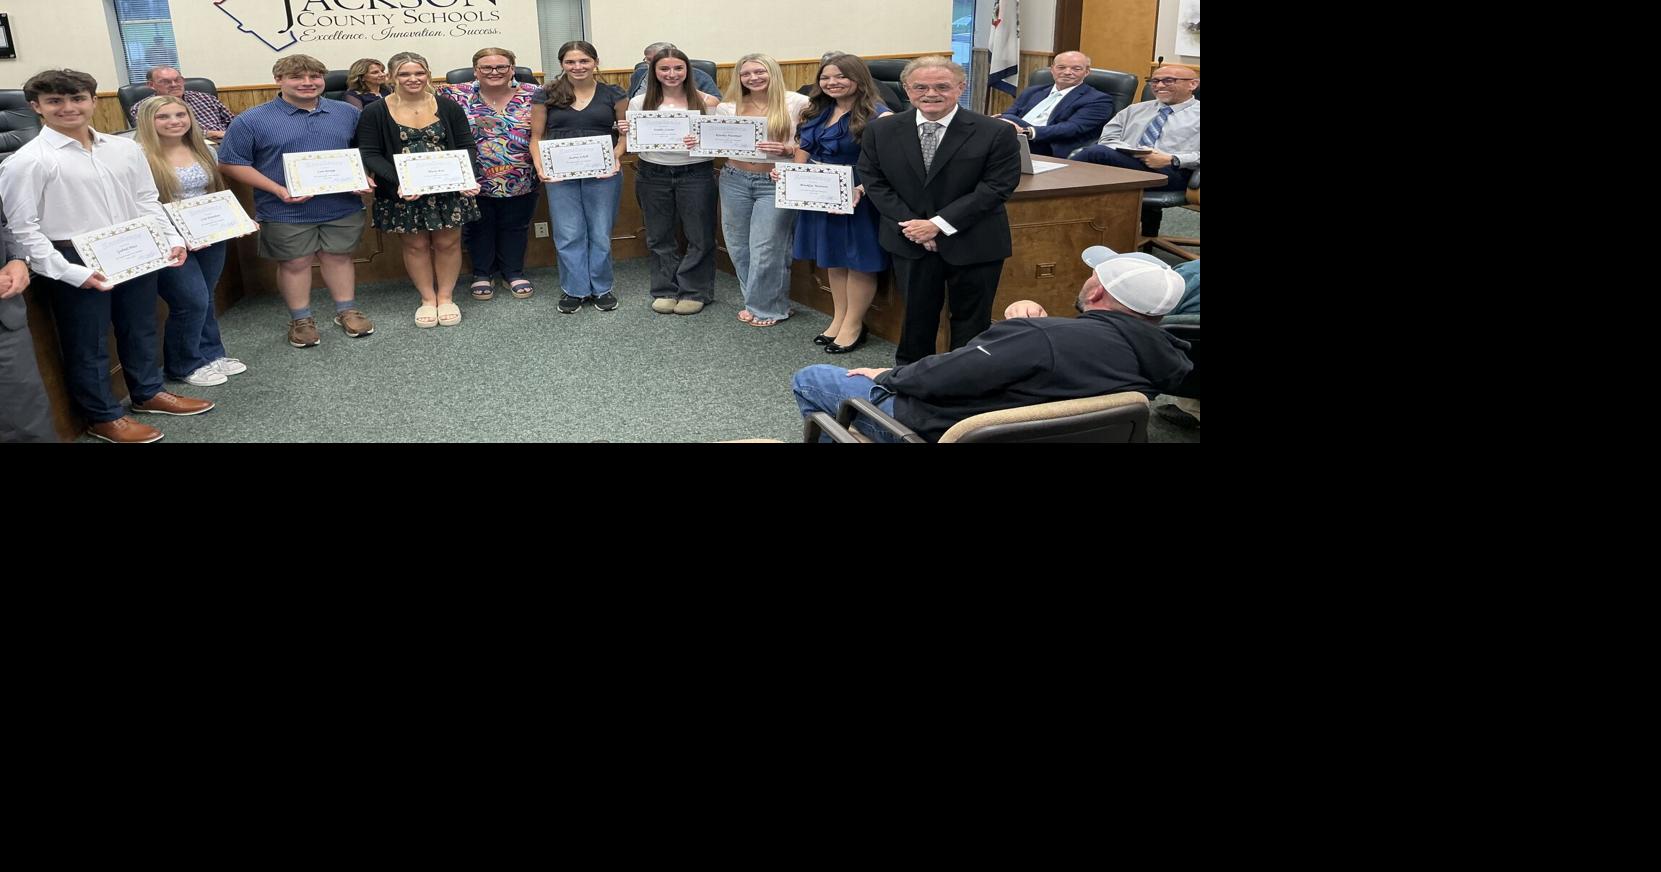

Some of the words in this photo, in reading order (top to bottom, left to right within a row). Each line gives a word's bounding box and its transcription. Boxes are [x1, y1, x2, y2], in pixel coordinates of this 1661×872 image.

[299, 29, 368, 42] Excellence.
[372, 26, 446, 41] Innovation.
[449, 24, 502, 37] Success.
